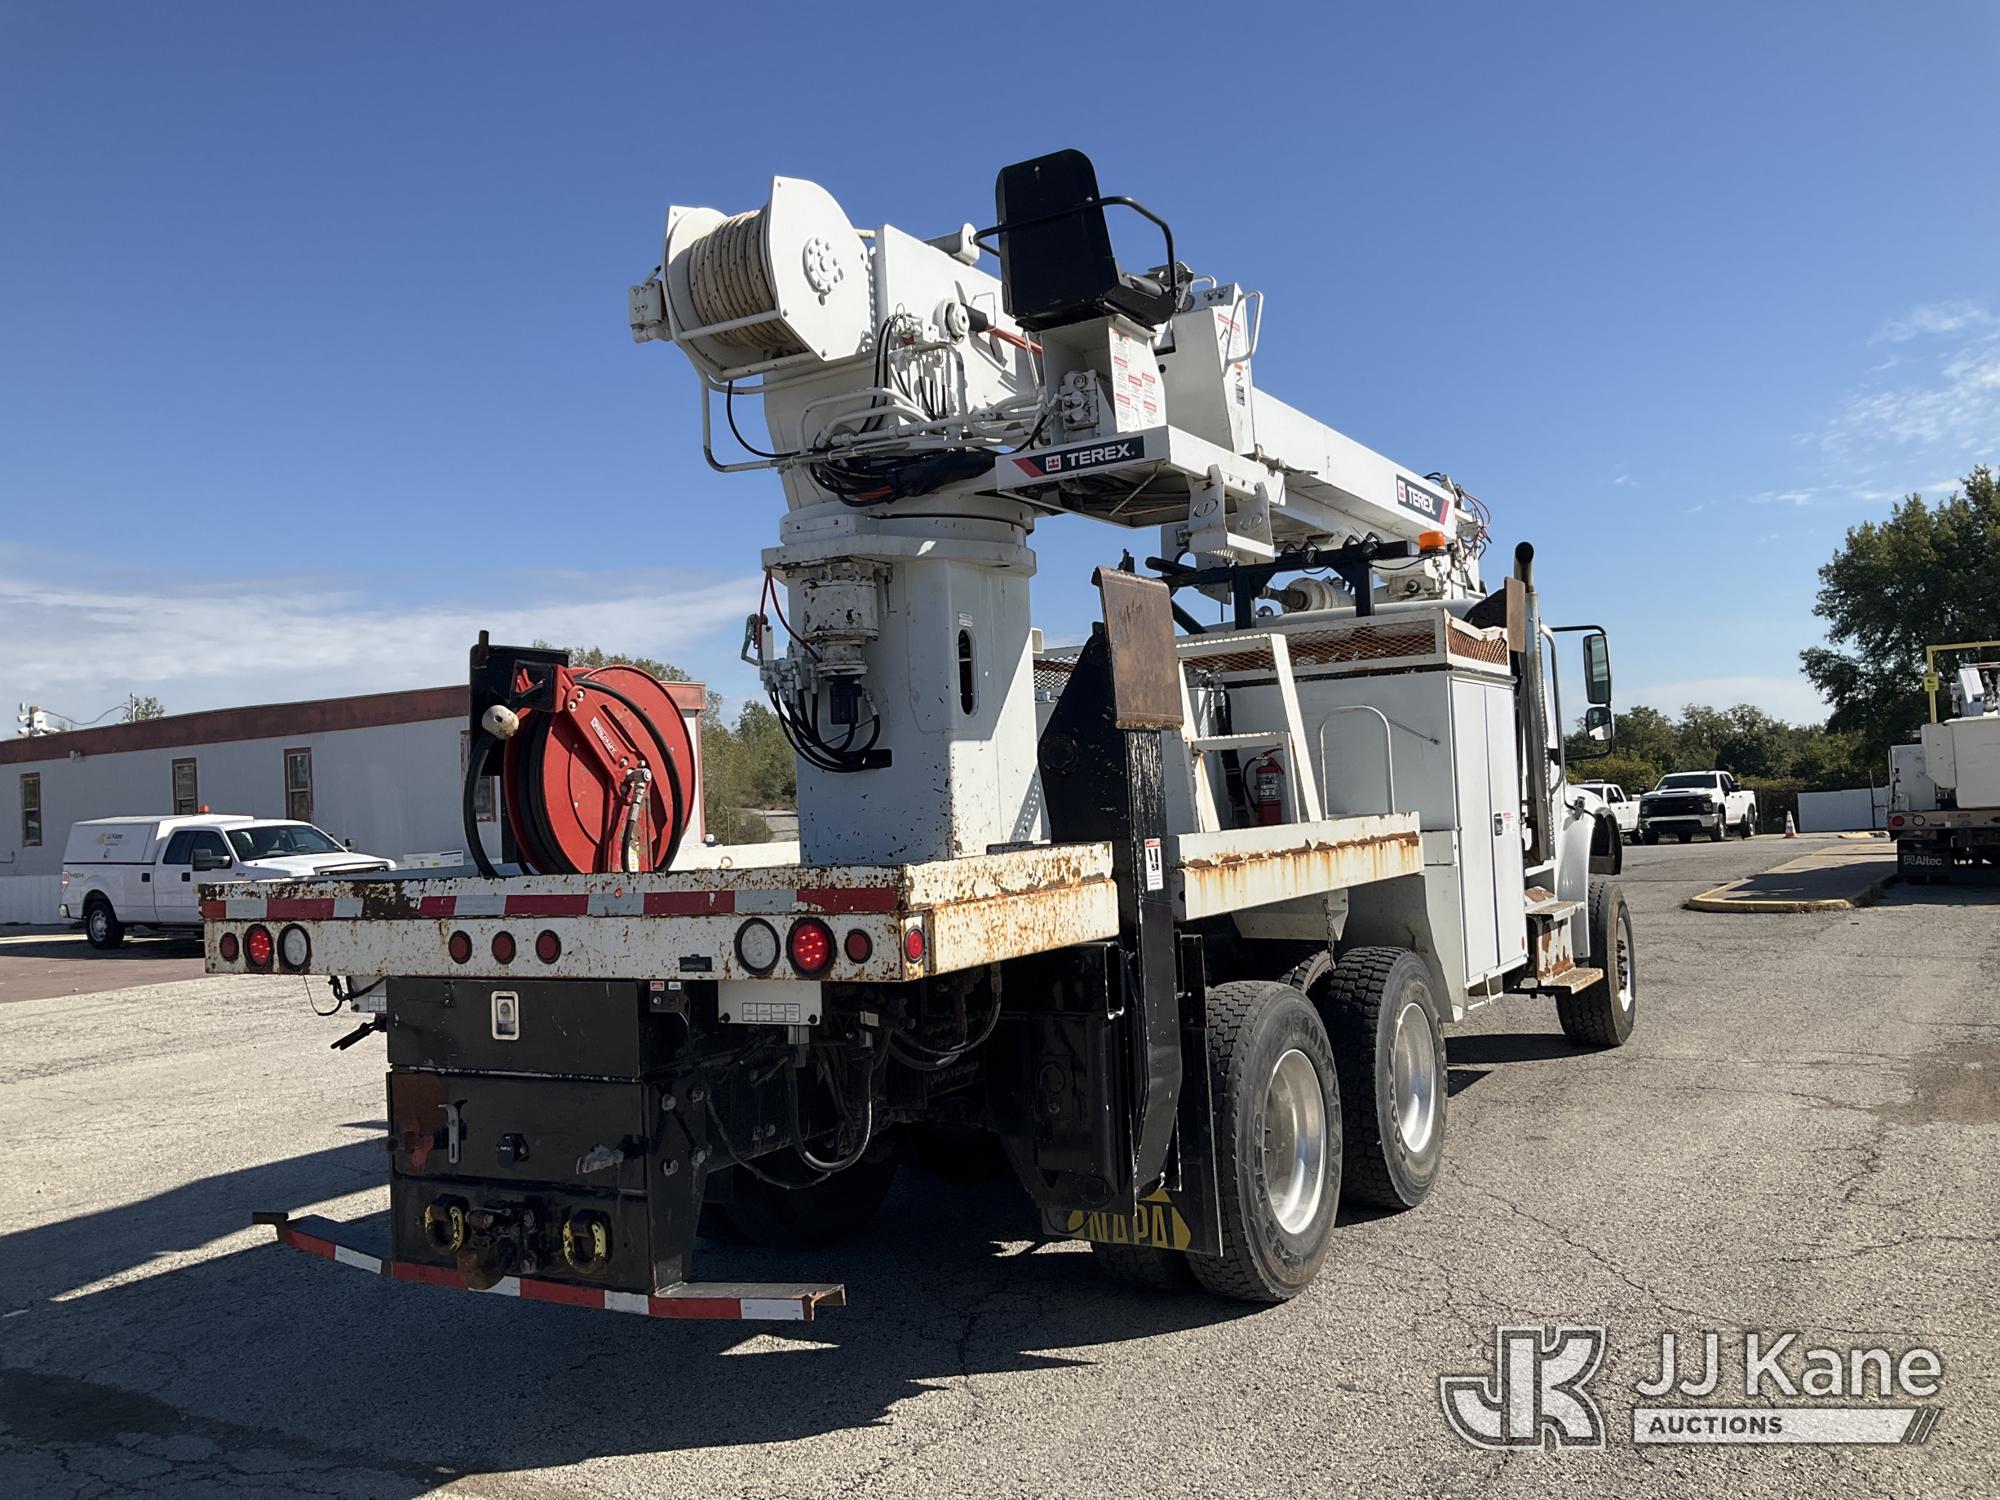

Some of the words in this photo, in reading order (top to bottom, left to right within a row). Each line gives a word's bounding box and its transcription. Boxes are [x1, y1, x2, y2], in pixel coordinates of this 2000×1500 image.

[1067, 443, 1131, 467] TEREX
[1407, 485, 1435, 515] TEREX
[1915, 855, 1943, 866] Altec
[1087, 1204, 1169, 1248] NAPA
